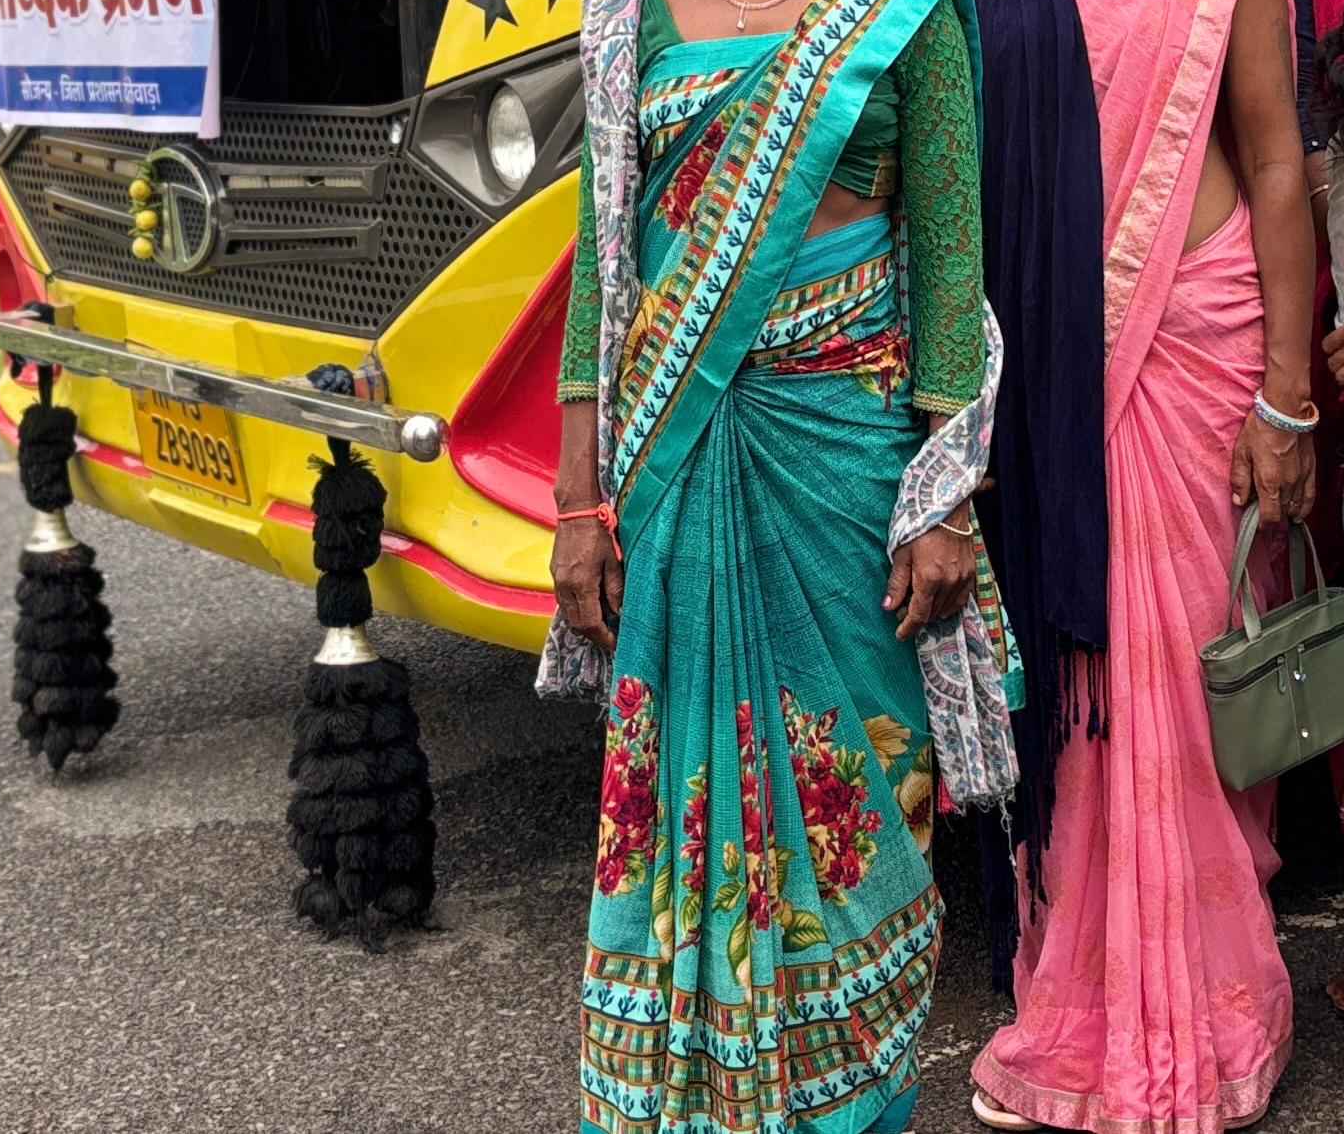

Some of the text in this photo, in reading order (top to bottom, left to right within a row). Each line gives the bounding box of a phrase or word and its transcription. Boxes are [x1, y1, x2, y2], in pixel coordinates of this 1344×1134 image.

[59, 75, 84, 102] जिला
[86, 81, 122, 104] प्रशासन
[151, 414, 237, 485] ZB9099
